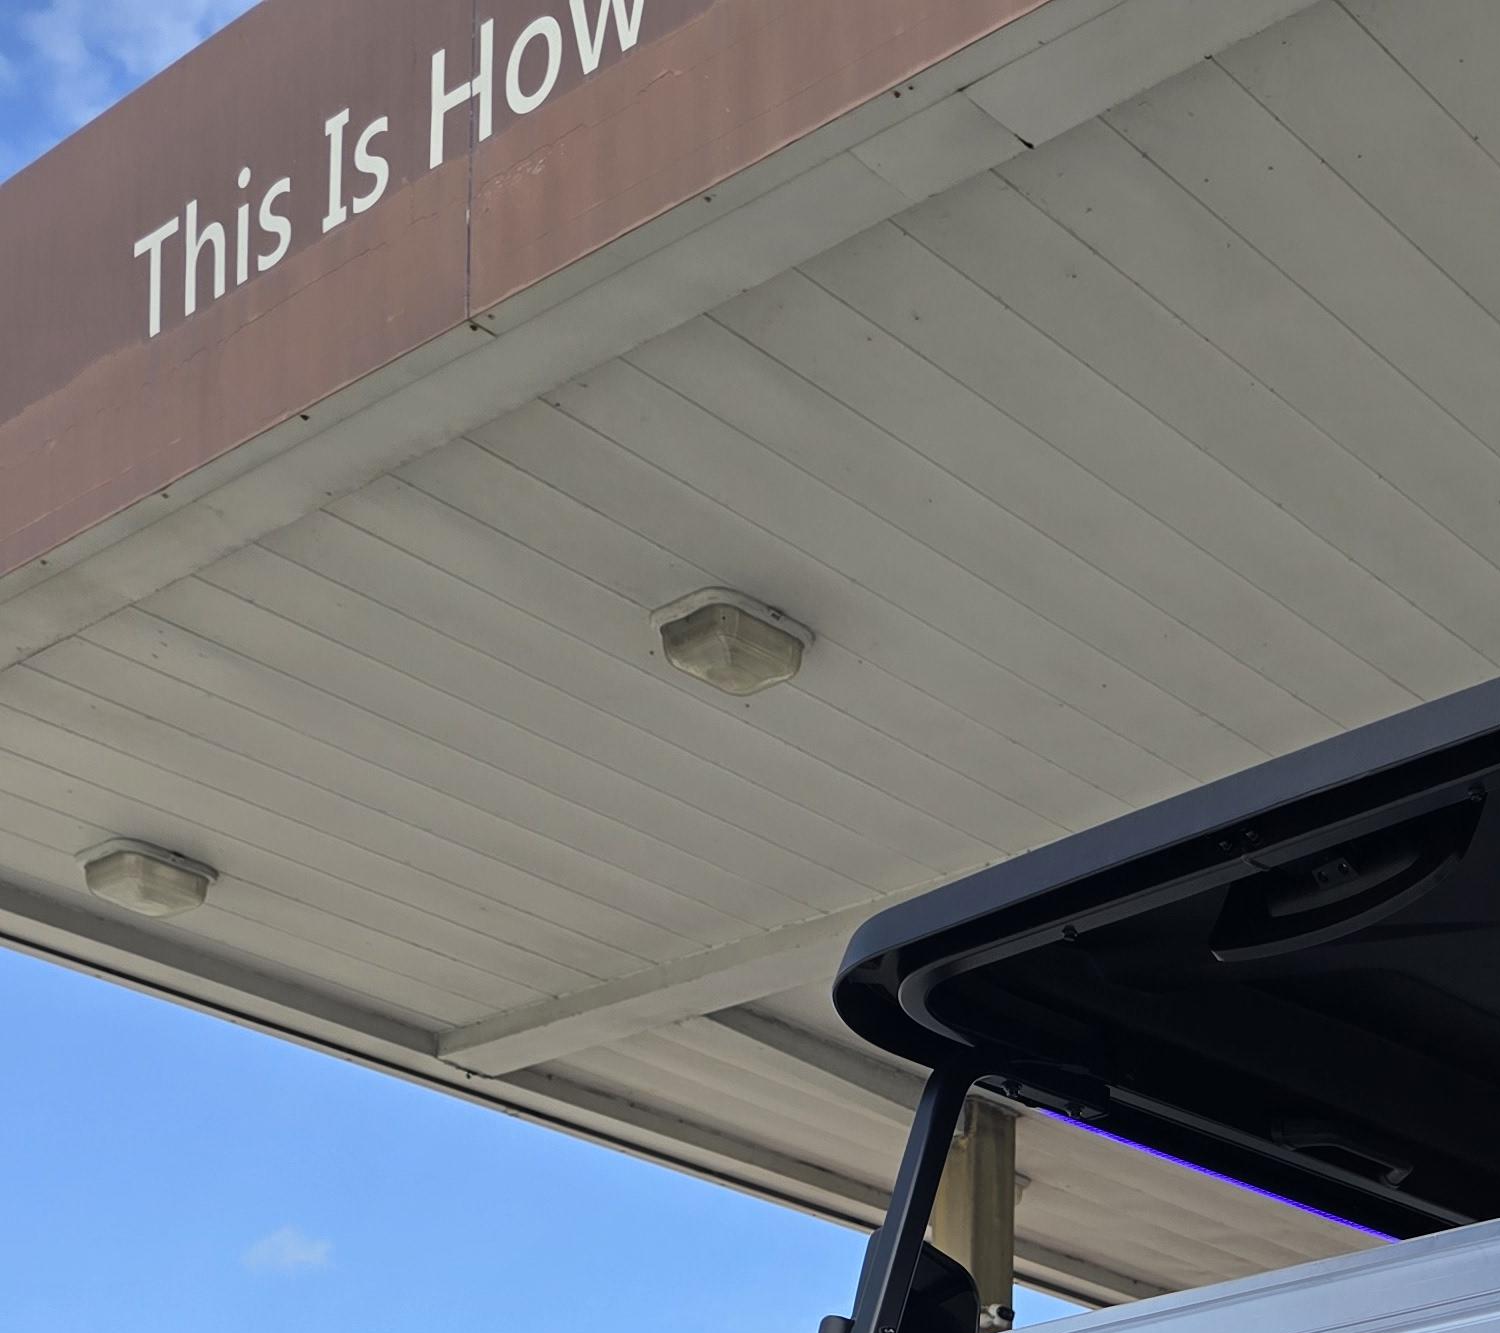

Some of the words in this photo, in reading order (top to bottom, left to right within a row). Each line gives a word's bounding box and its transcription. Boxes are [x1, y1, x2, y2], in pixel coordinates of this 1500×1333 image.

[133, 167, 292, 339] This
[322, 107, 390, 234] Is
[429, 0, 645, 170] How
